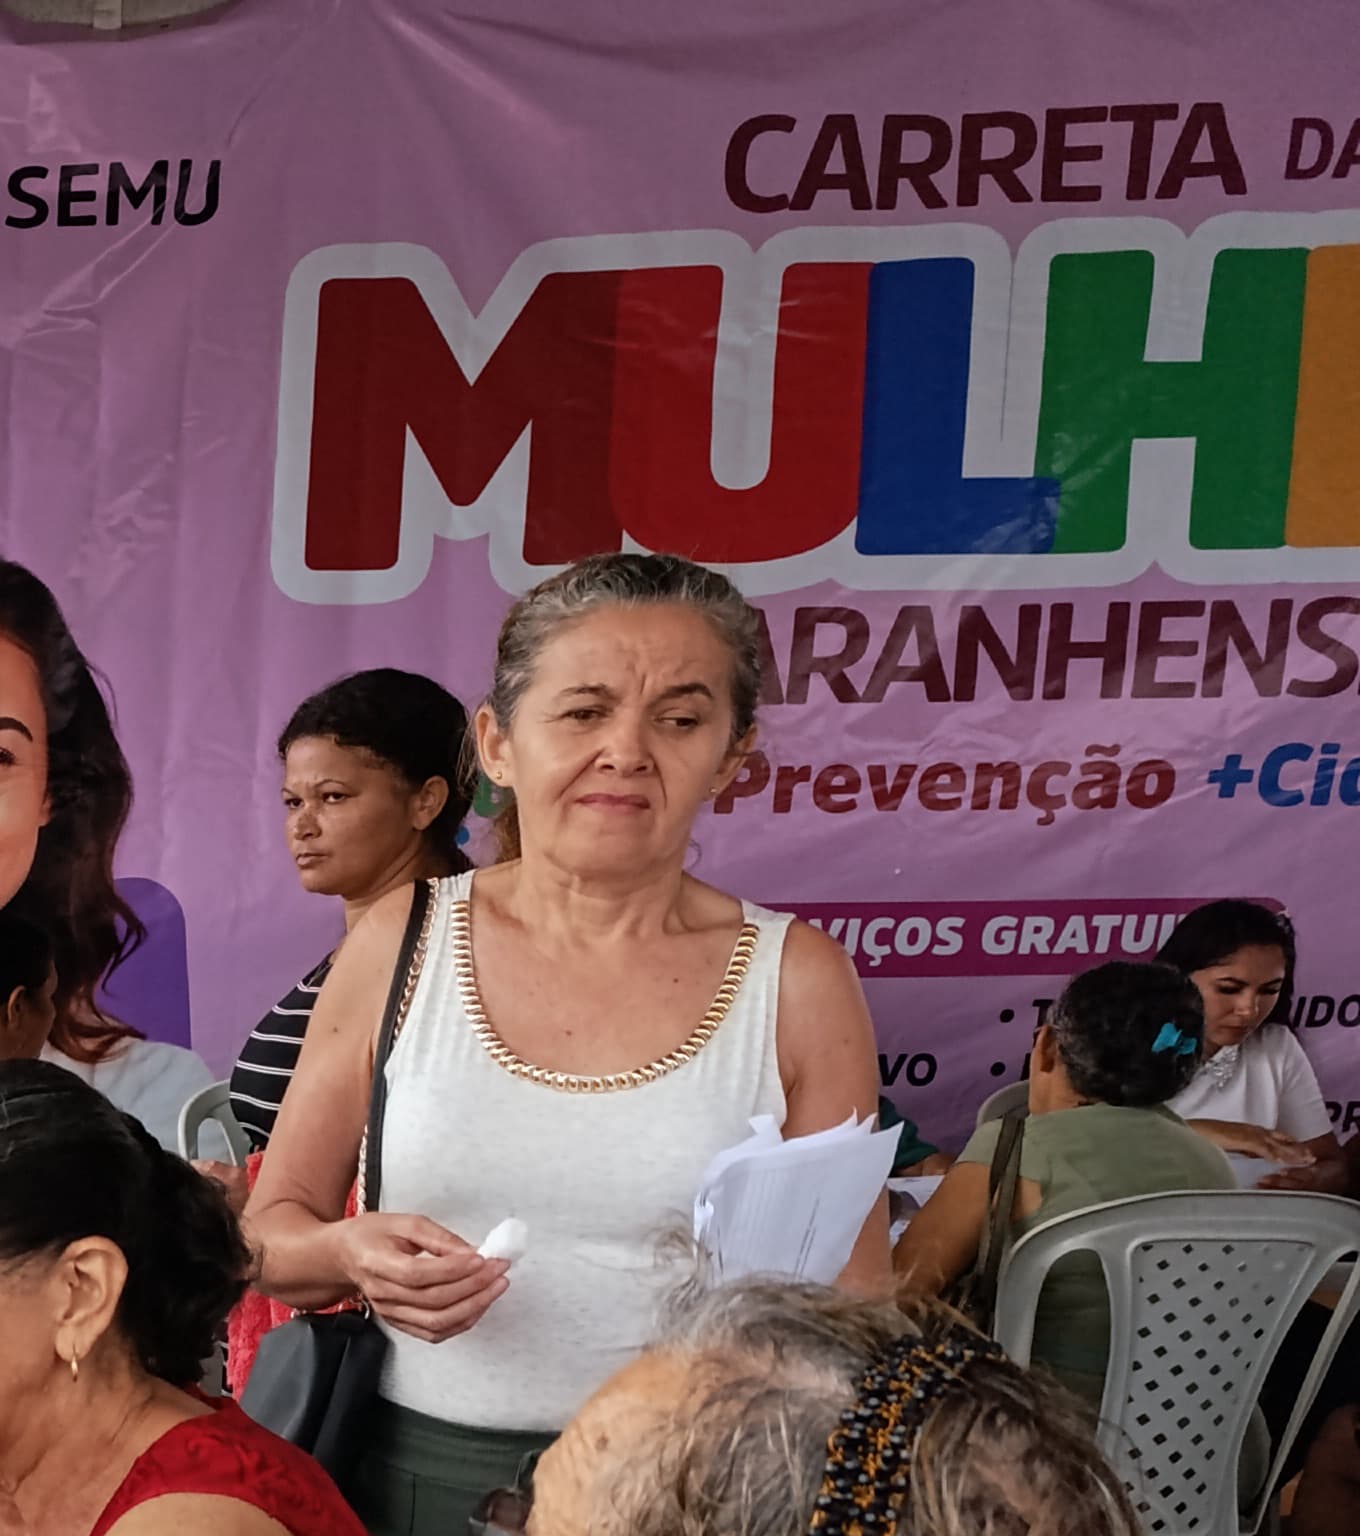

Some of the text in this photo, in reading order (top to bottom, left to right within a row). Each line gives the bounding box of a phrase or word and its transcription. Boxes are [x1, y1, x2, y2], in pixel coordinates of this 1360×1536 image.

[4, 159, 223, 231] SEMU
[723, 101, 1248, 213] CARRETA
[304, 245, 1360, 574] MULH
[713, 742, 1177, 826] Prevenção
[981, 913, 1188, 956] GRATUI
